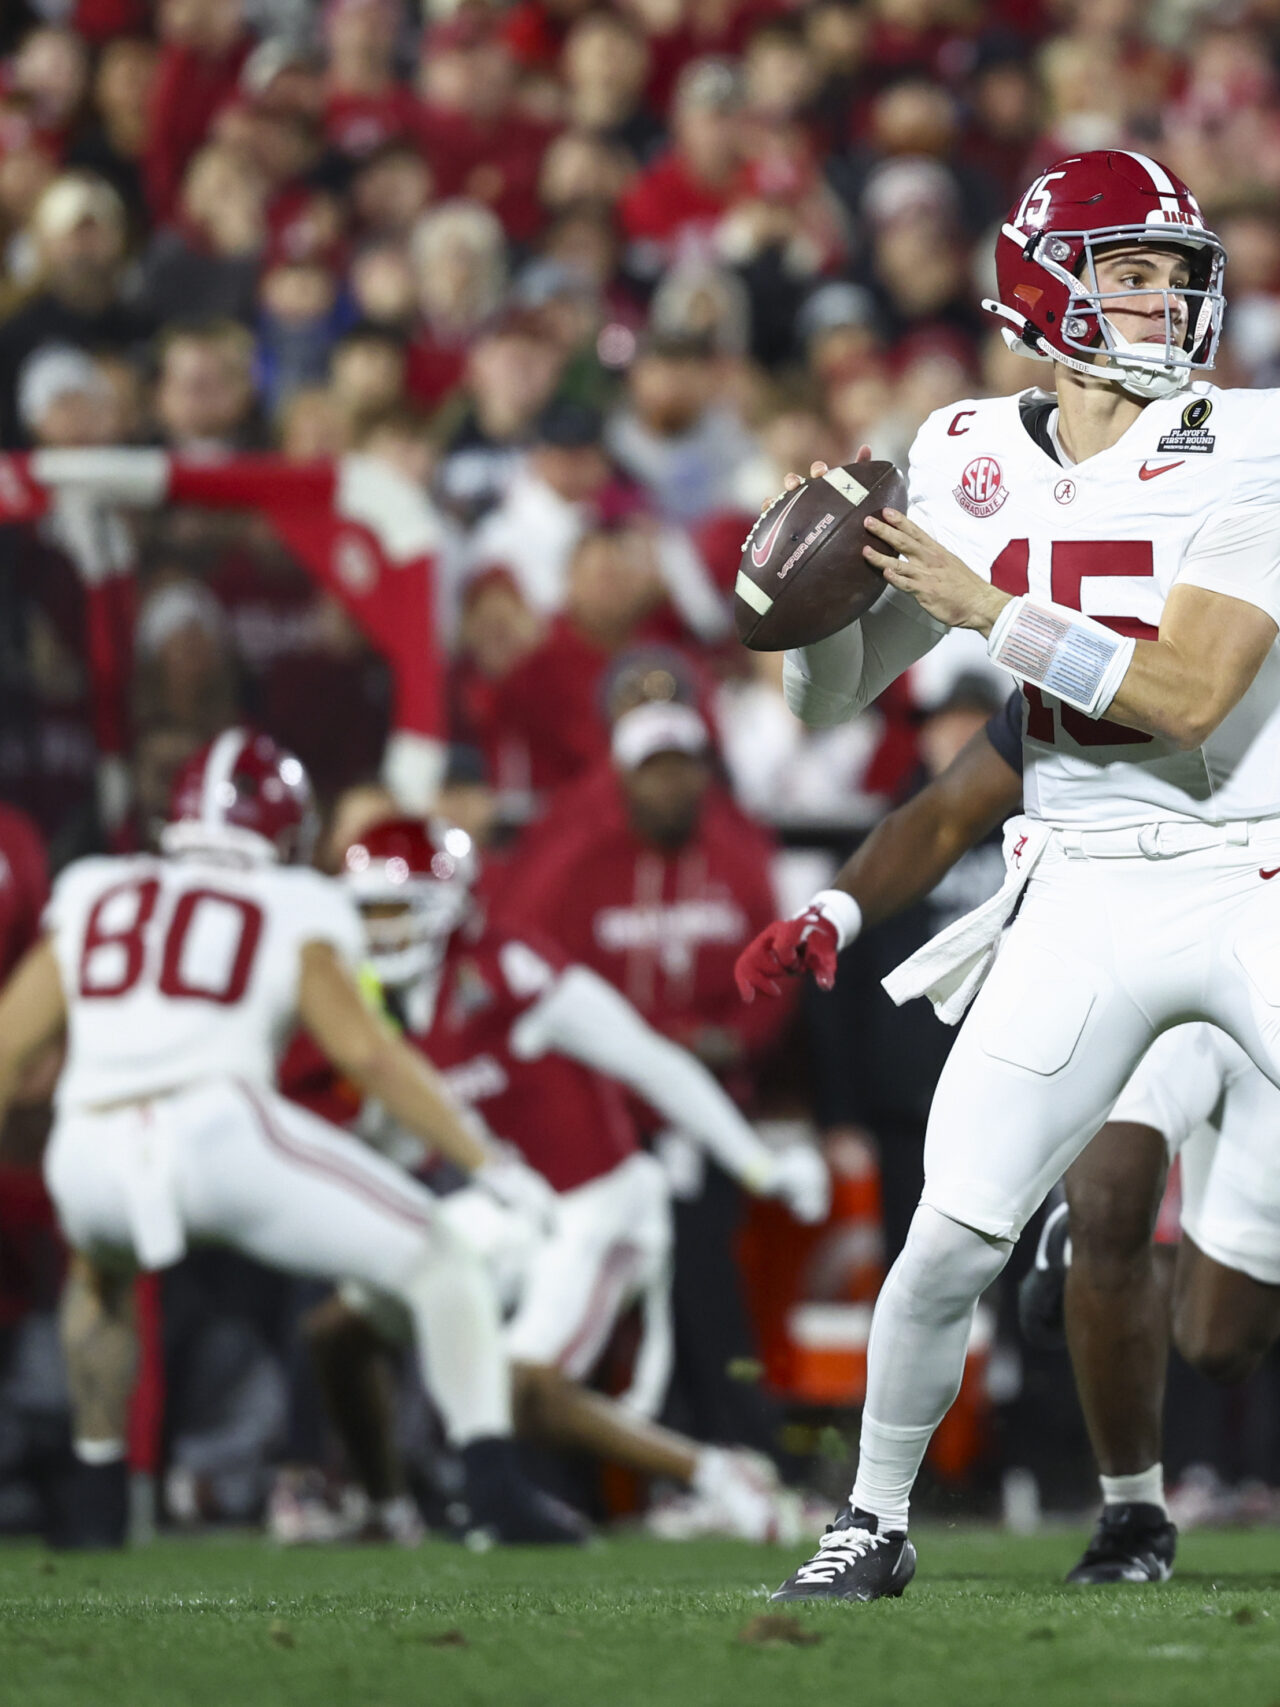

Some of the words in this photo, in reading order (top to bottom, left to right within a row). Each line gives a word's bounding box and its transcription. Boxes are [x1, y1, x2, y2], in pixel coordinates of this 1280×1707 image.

[1013, 171, 1067, 230] 15
[1163, 210, 1194, 226] BAMA
[1040, 339, 1069, 364] CRIMSON
[1071, 360, 1089, 373] TIDE
[947, 410, 977, 437] C
[1171, 429, 1208, 437] PLAYOFF
[1160, 436, 1186, 445] FIRST
[1186, 436, 1215, 445] ROUND
[962, 458, 1001, 501] SEC
[959, 496, 1000, 517] GRADUATE
[804, 513, 835, 546] ELITE
[79, 877, 264, 1007] 80
